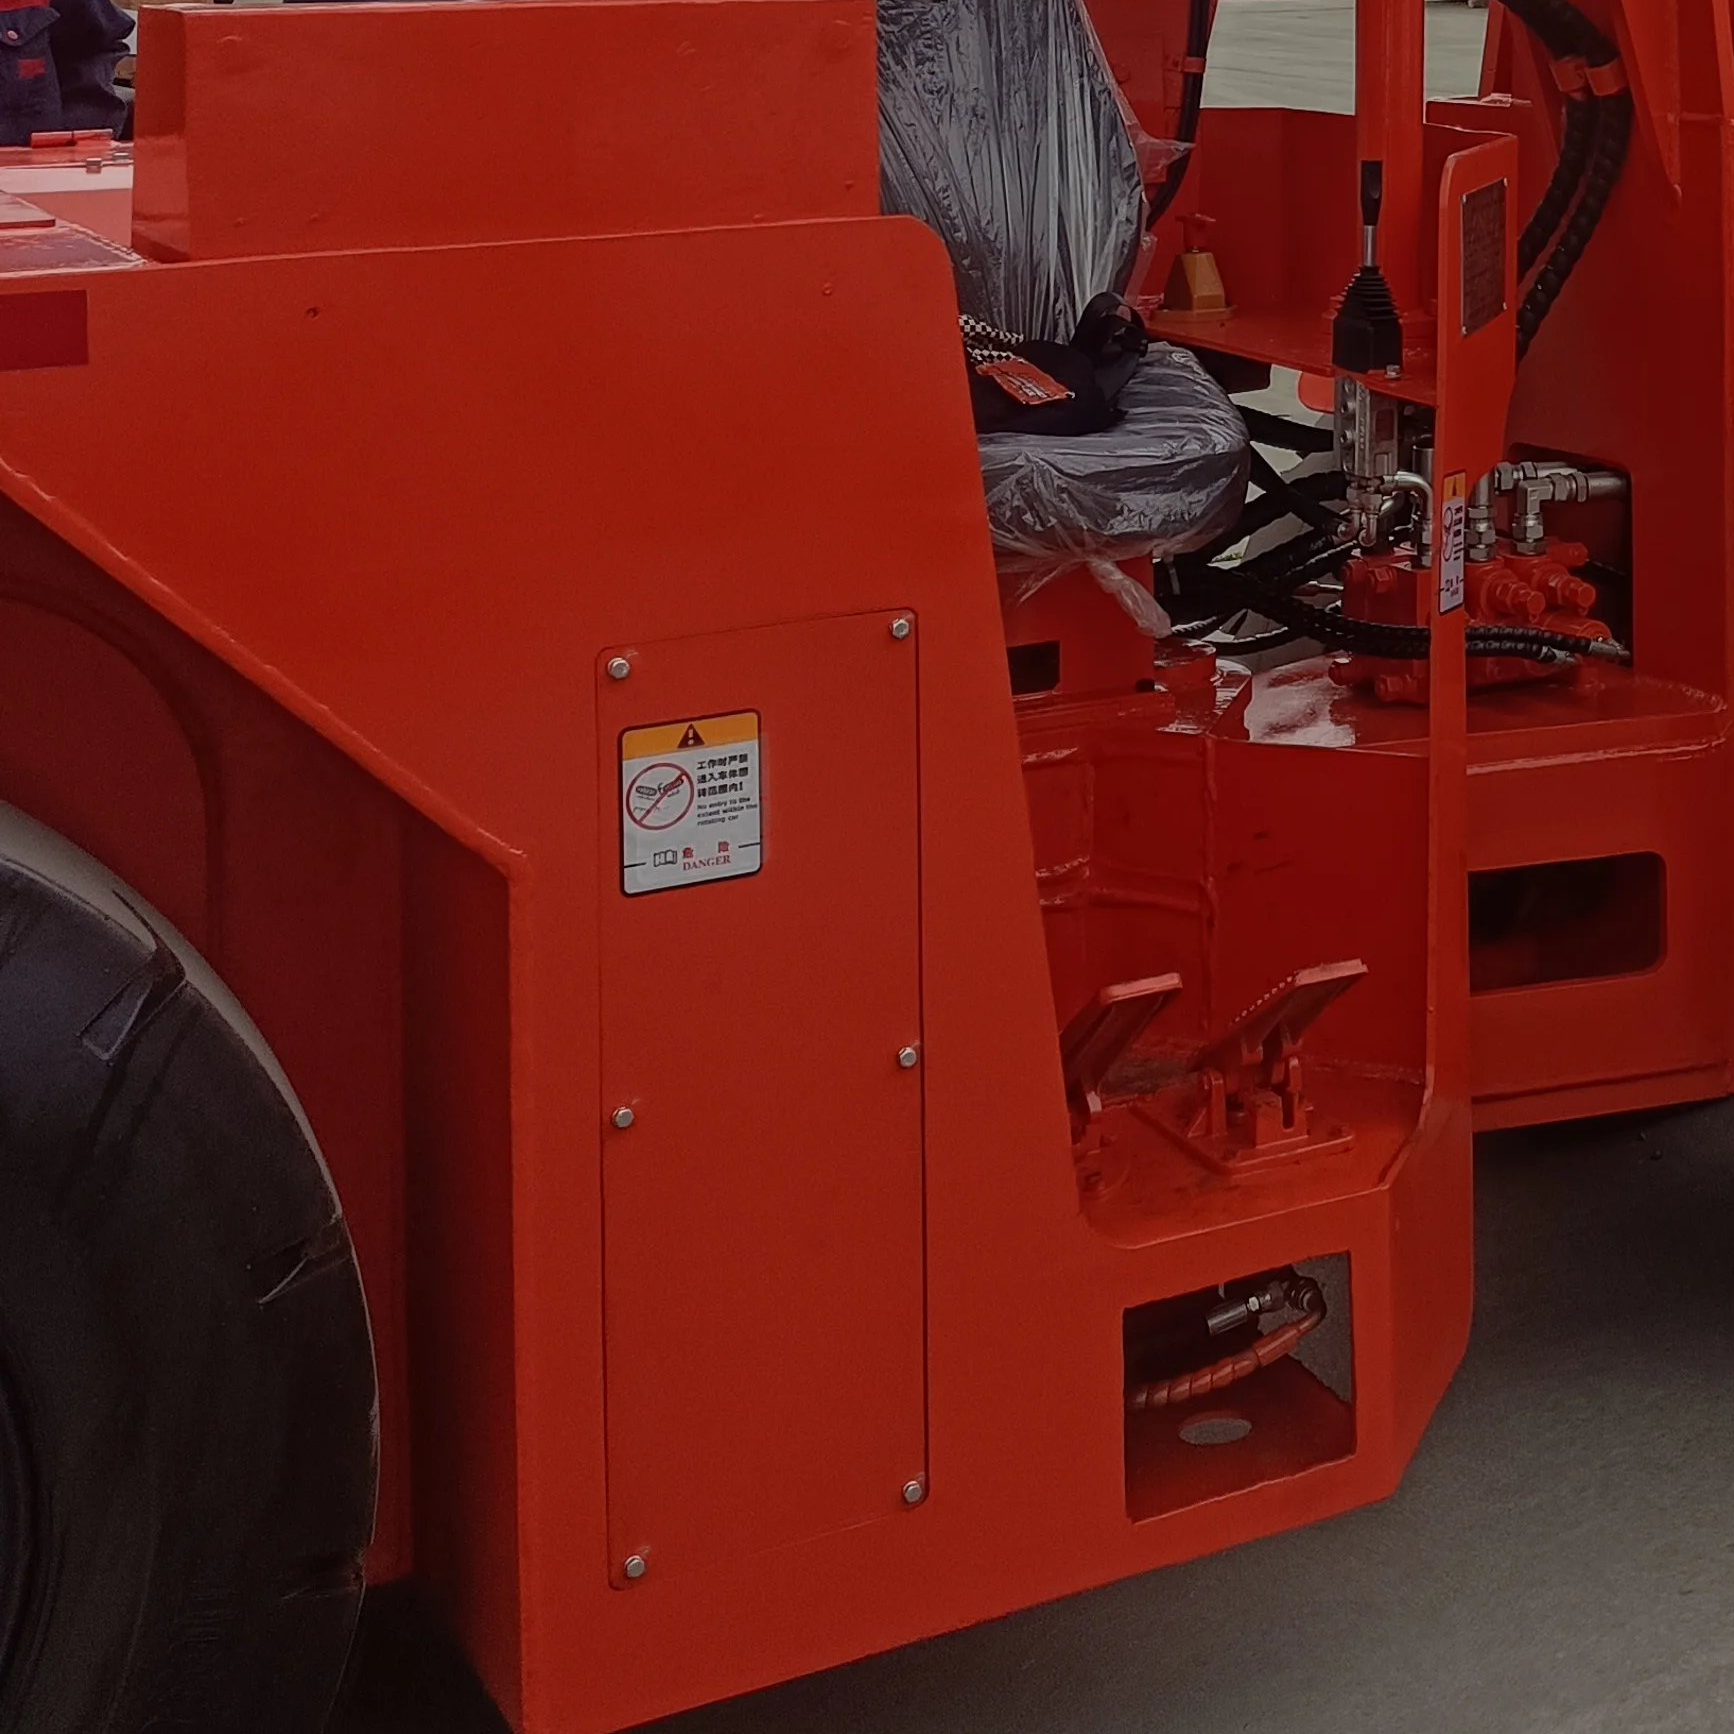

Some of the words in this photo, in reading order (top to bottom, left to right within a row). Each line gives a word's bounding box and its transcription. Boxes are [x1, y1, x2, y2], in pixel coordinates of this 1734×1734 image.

[696, 753, 748, 770] 工作时严禁
[682, 855, 731, 871] DANGER
